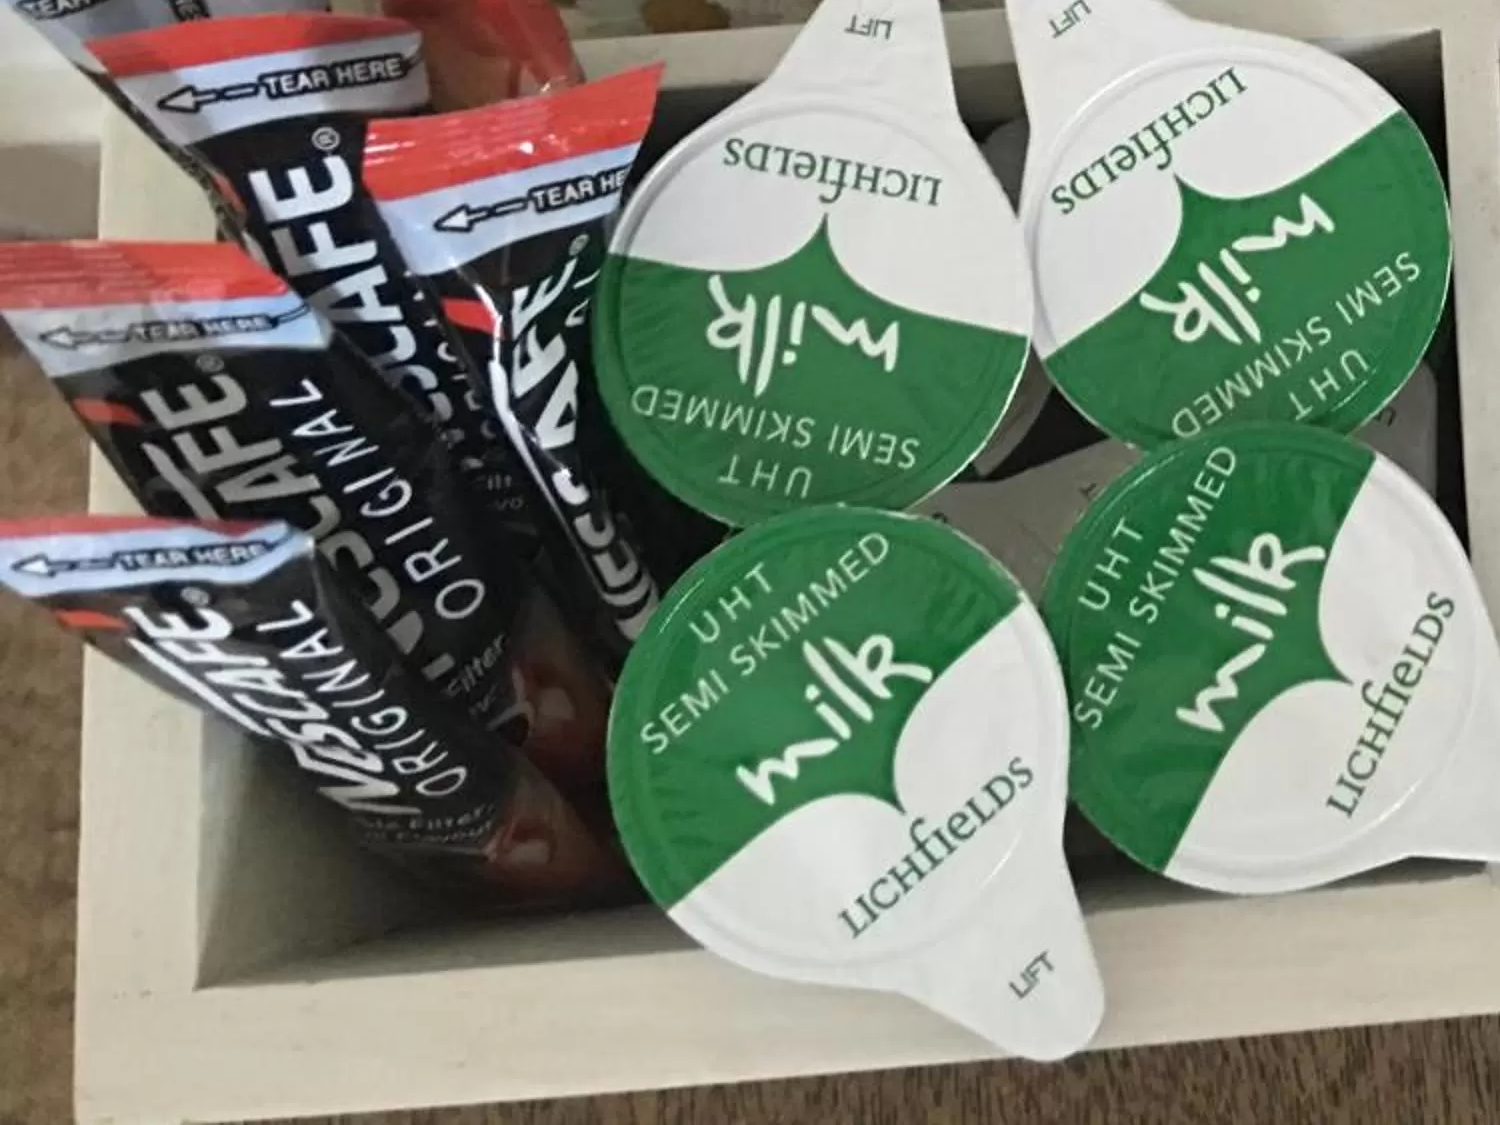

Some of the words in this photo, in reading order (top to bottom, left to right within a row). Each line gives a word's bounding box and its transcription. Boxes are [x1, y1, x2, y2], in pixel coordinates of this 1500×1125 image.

[845, 14, 893, 39] LIFT
[266, 68, 329, 96] TEAR
[336, 57, 402, 85] HERE
[532, 180, 595, 208] TEAR
[600, 170, 626, 192] HE
[1139, 193, 1336, 344] milk
[1336, 251, 1421, 326] SEMI
[136, 322, 198, 341] TEAR
[205, 316, 272, 335] HERE
[705, 274, 900, 397] milk
[1171, 314, 1333, 439] SKIMMED
[1287, 349, 1371, 422] UHT
[630, 386, 815, 447] SKIMMED
[828, 425, 920, 469] SEMI
[270, 378, 487, 620] ORIGINAL
[719, 456, 813, 499] UHT
[119, 546, 190, 570] TEAR
[196, 541, 266, 566] HERE
[1073, 634, 1142, 730] SEMI
[1129, 445, 1237, 625] SKIMMED
[1078, 516, 1144, 612] UHT
[688, 563, 773, 644] UHT
[1176, 532, 1327, 733] milk
[641, 669, 729, 754] SEMI
[729, 532, 890, 677] SKIMMED
[256, 598, 469, 797] ORIGINAL
[735, 634, 933, 806] milk
[1009, 950, 1056, 1000] LIFT
